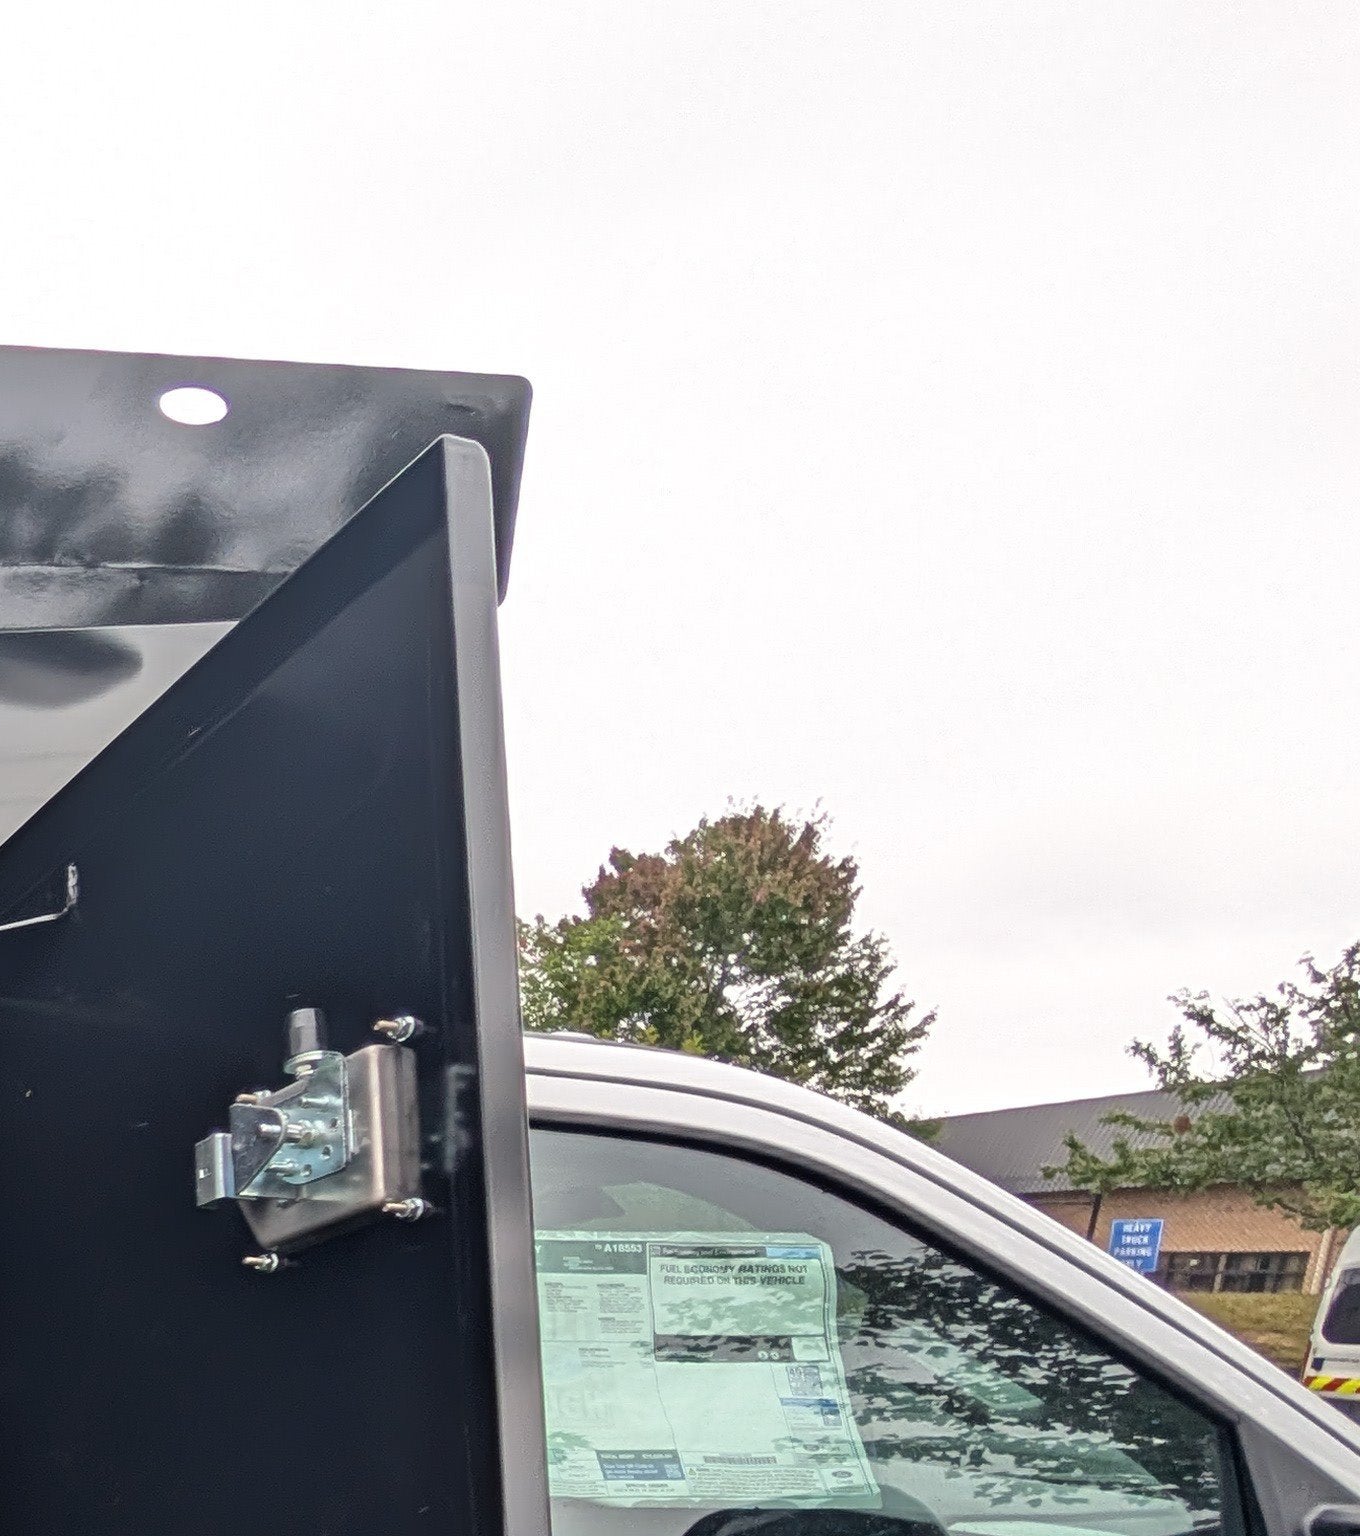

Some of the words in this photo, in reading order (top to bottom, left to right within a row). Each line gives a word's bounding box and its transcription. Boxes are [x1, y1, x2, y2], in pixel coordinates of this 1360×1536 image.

[1122, 1223, 1152, 1233] HEAVY
[1121, 1235, 1149, 1245] TRUCK
[1113, 1247, 1153, 1257] PARKING
[660, 1264, 682, 1273] FUEL
[684, 1264, 735, 1274] ECONOMY
[738, 1264, 786, 1274] RATINGS
[788, 1264, 808, 1273] NOT
[664, 1275, 715, 1285] REQUIRED
[716, 1276, 730, 1285] ON
[733, 1275, 757, 1285] THIS
[759, 1275, 806, 1285] VEHICLE
